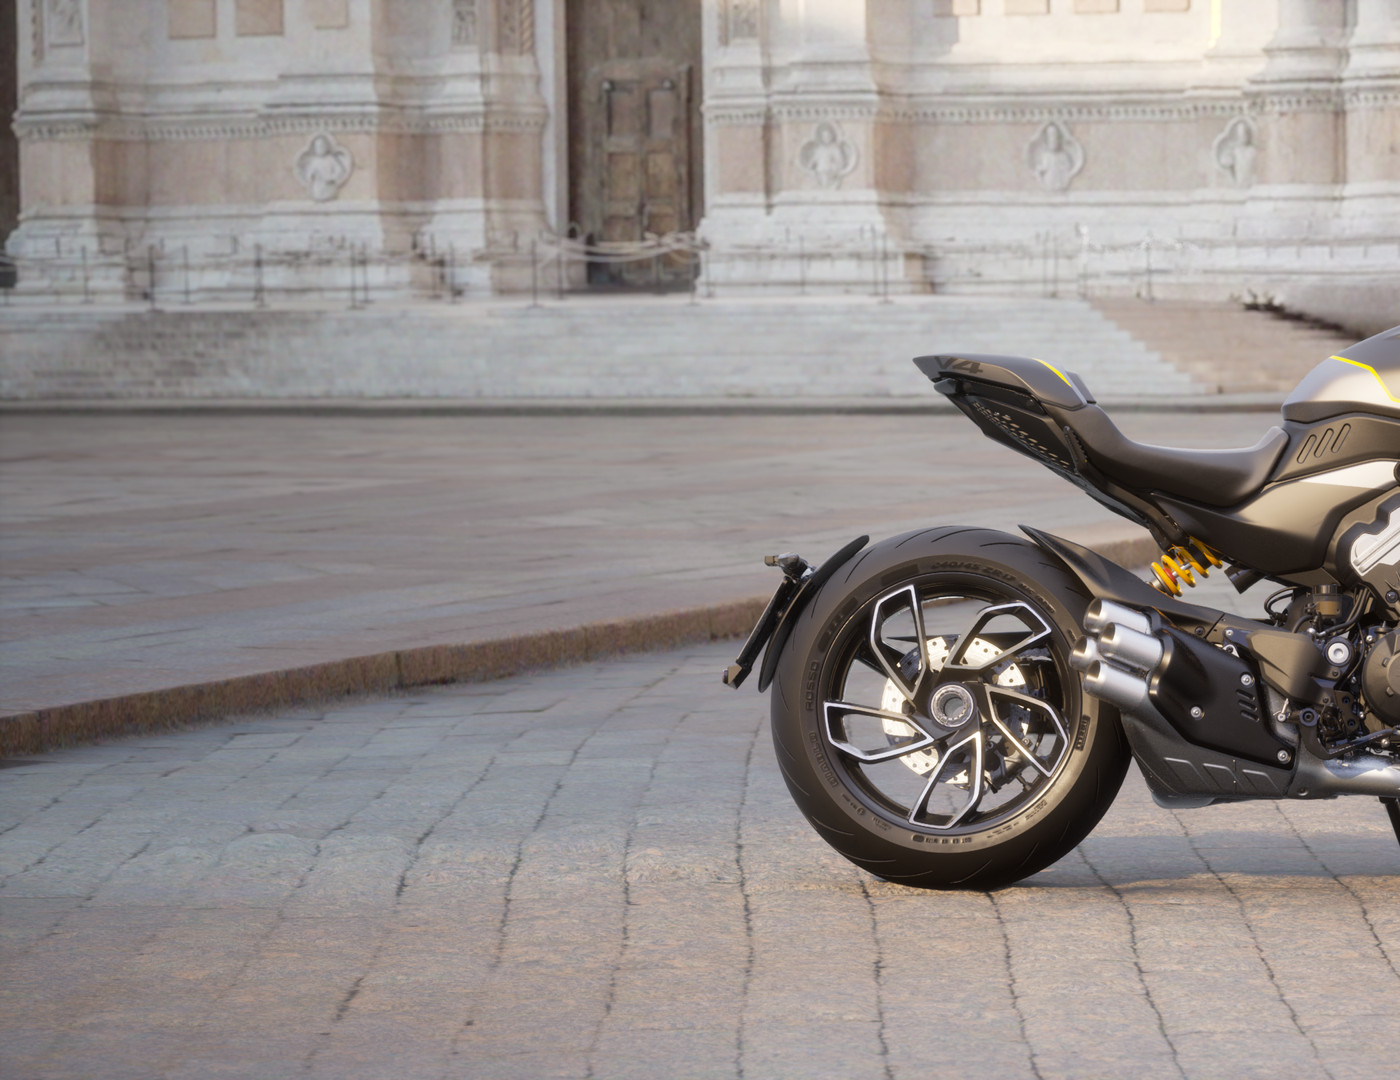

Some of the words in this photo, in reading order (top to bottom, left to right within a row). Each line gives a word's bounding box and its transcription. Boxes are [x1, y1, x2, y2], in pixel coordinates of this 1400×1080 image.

[934, 355, 983, 374] V4
[805, 660, 820, 712] ROSSO
[808, 730, 839, 788] DIABLO
